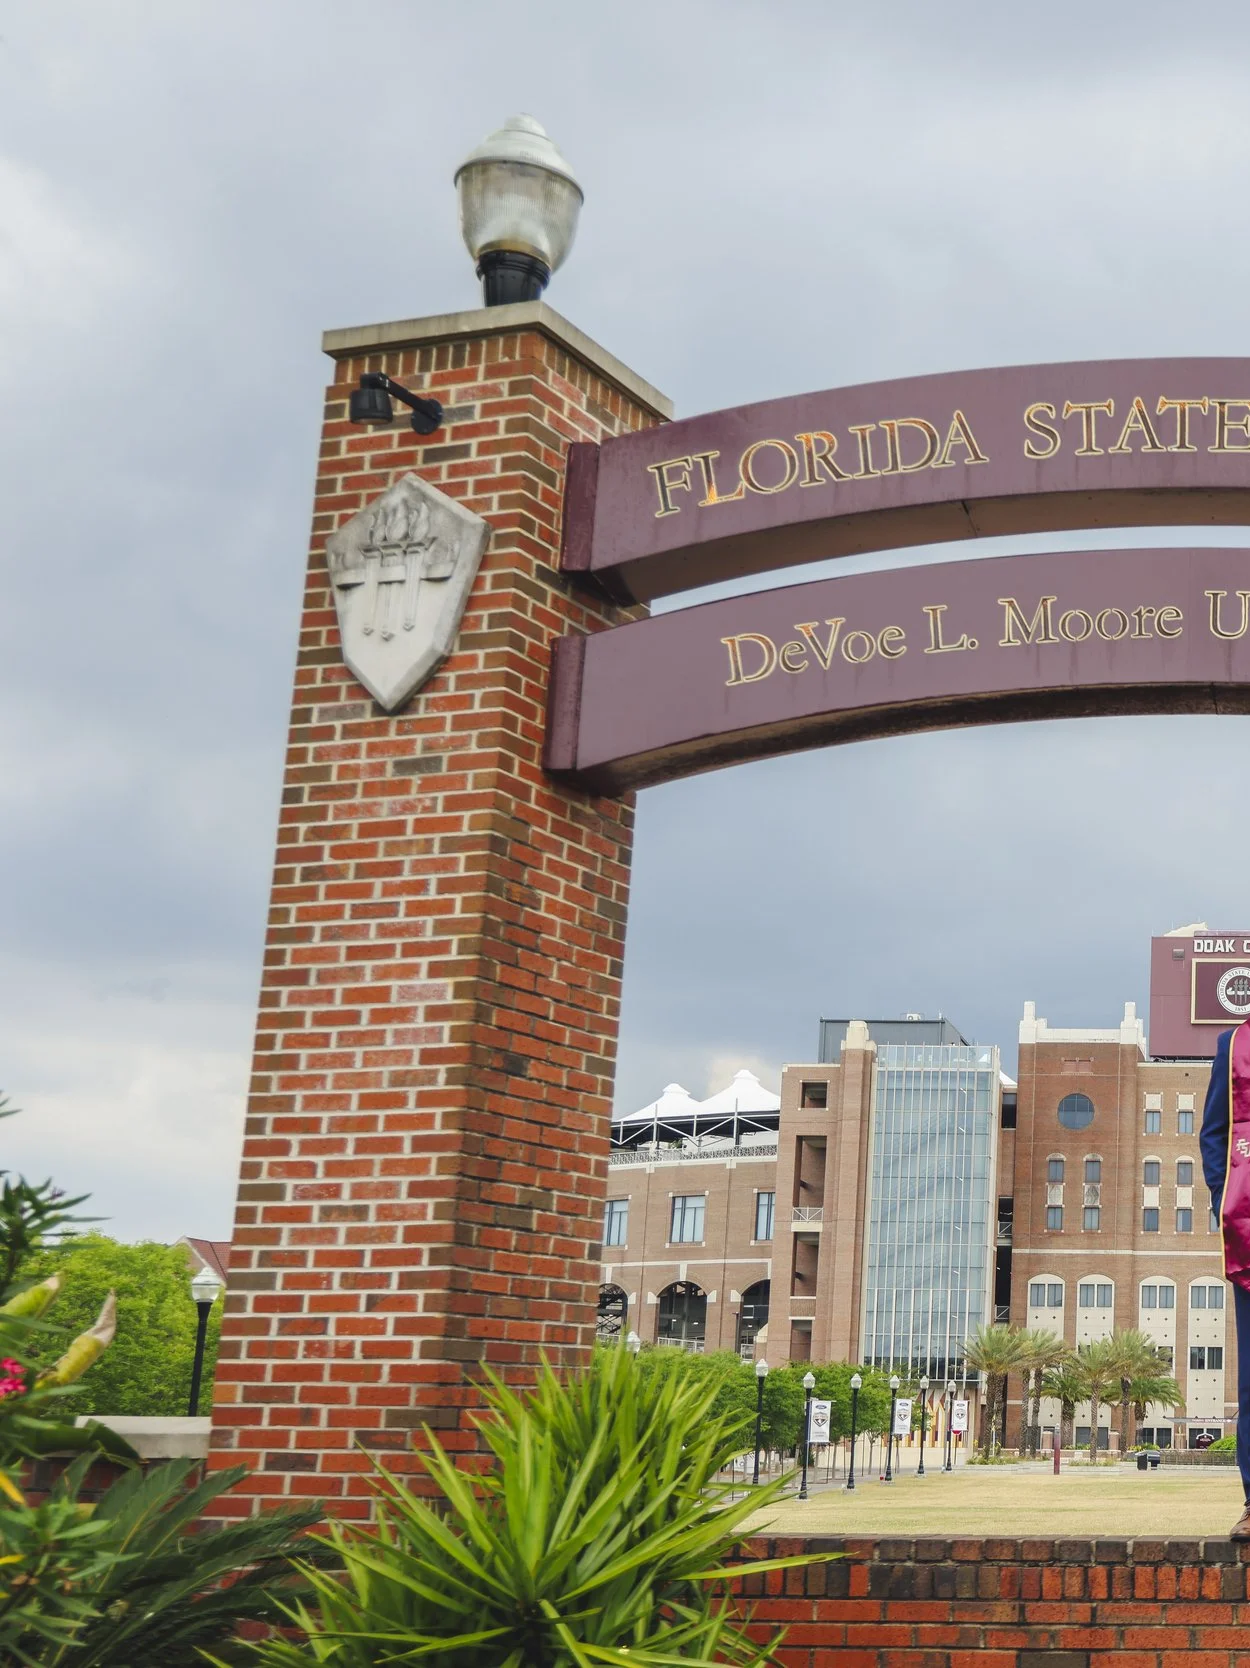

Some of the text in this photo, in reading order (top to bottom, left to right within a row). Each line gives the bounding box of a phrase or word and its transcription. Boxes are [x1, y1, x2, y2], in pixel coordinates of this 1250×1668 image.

[648, 409, 990, 518] FLORIDA
[721, 617, 907, 687] DeVoe
[923, 604, 979, 655] L.
[998, 595, 1183, 647] Moore
[1193, 939, 1236, 954] DOAK
